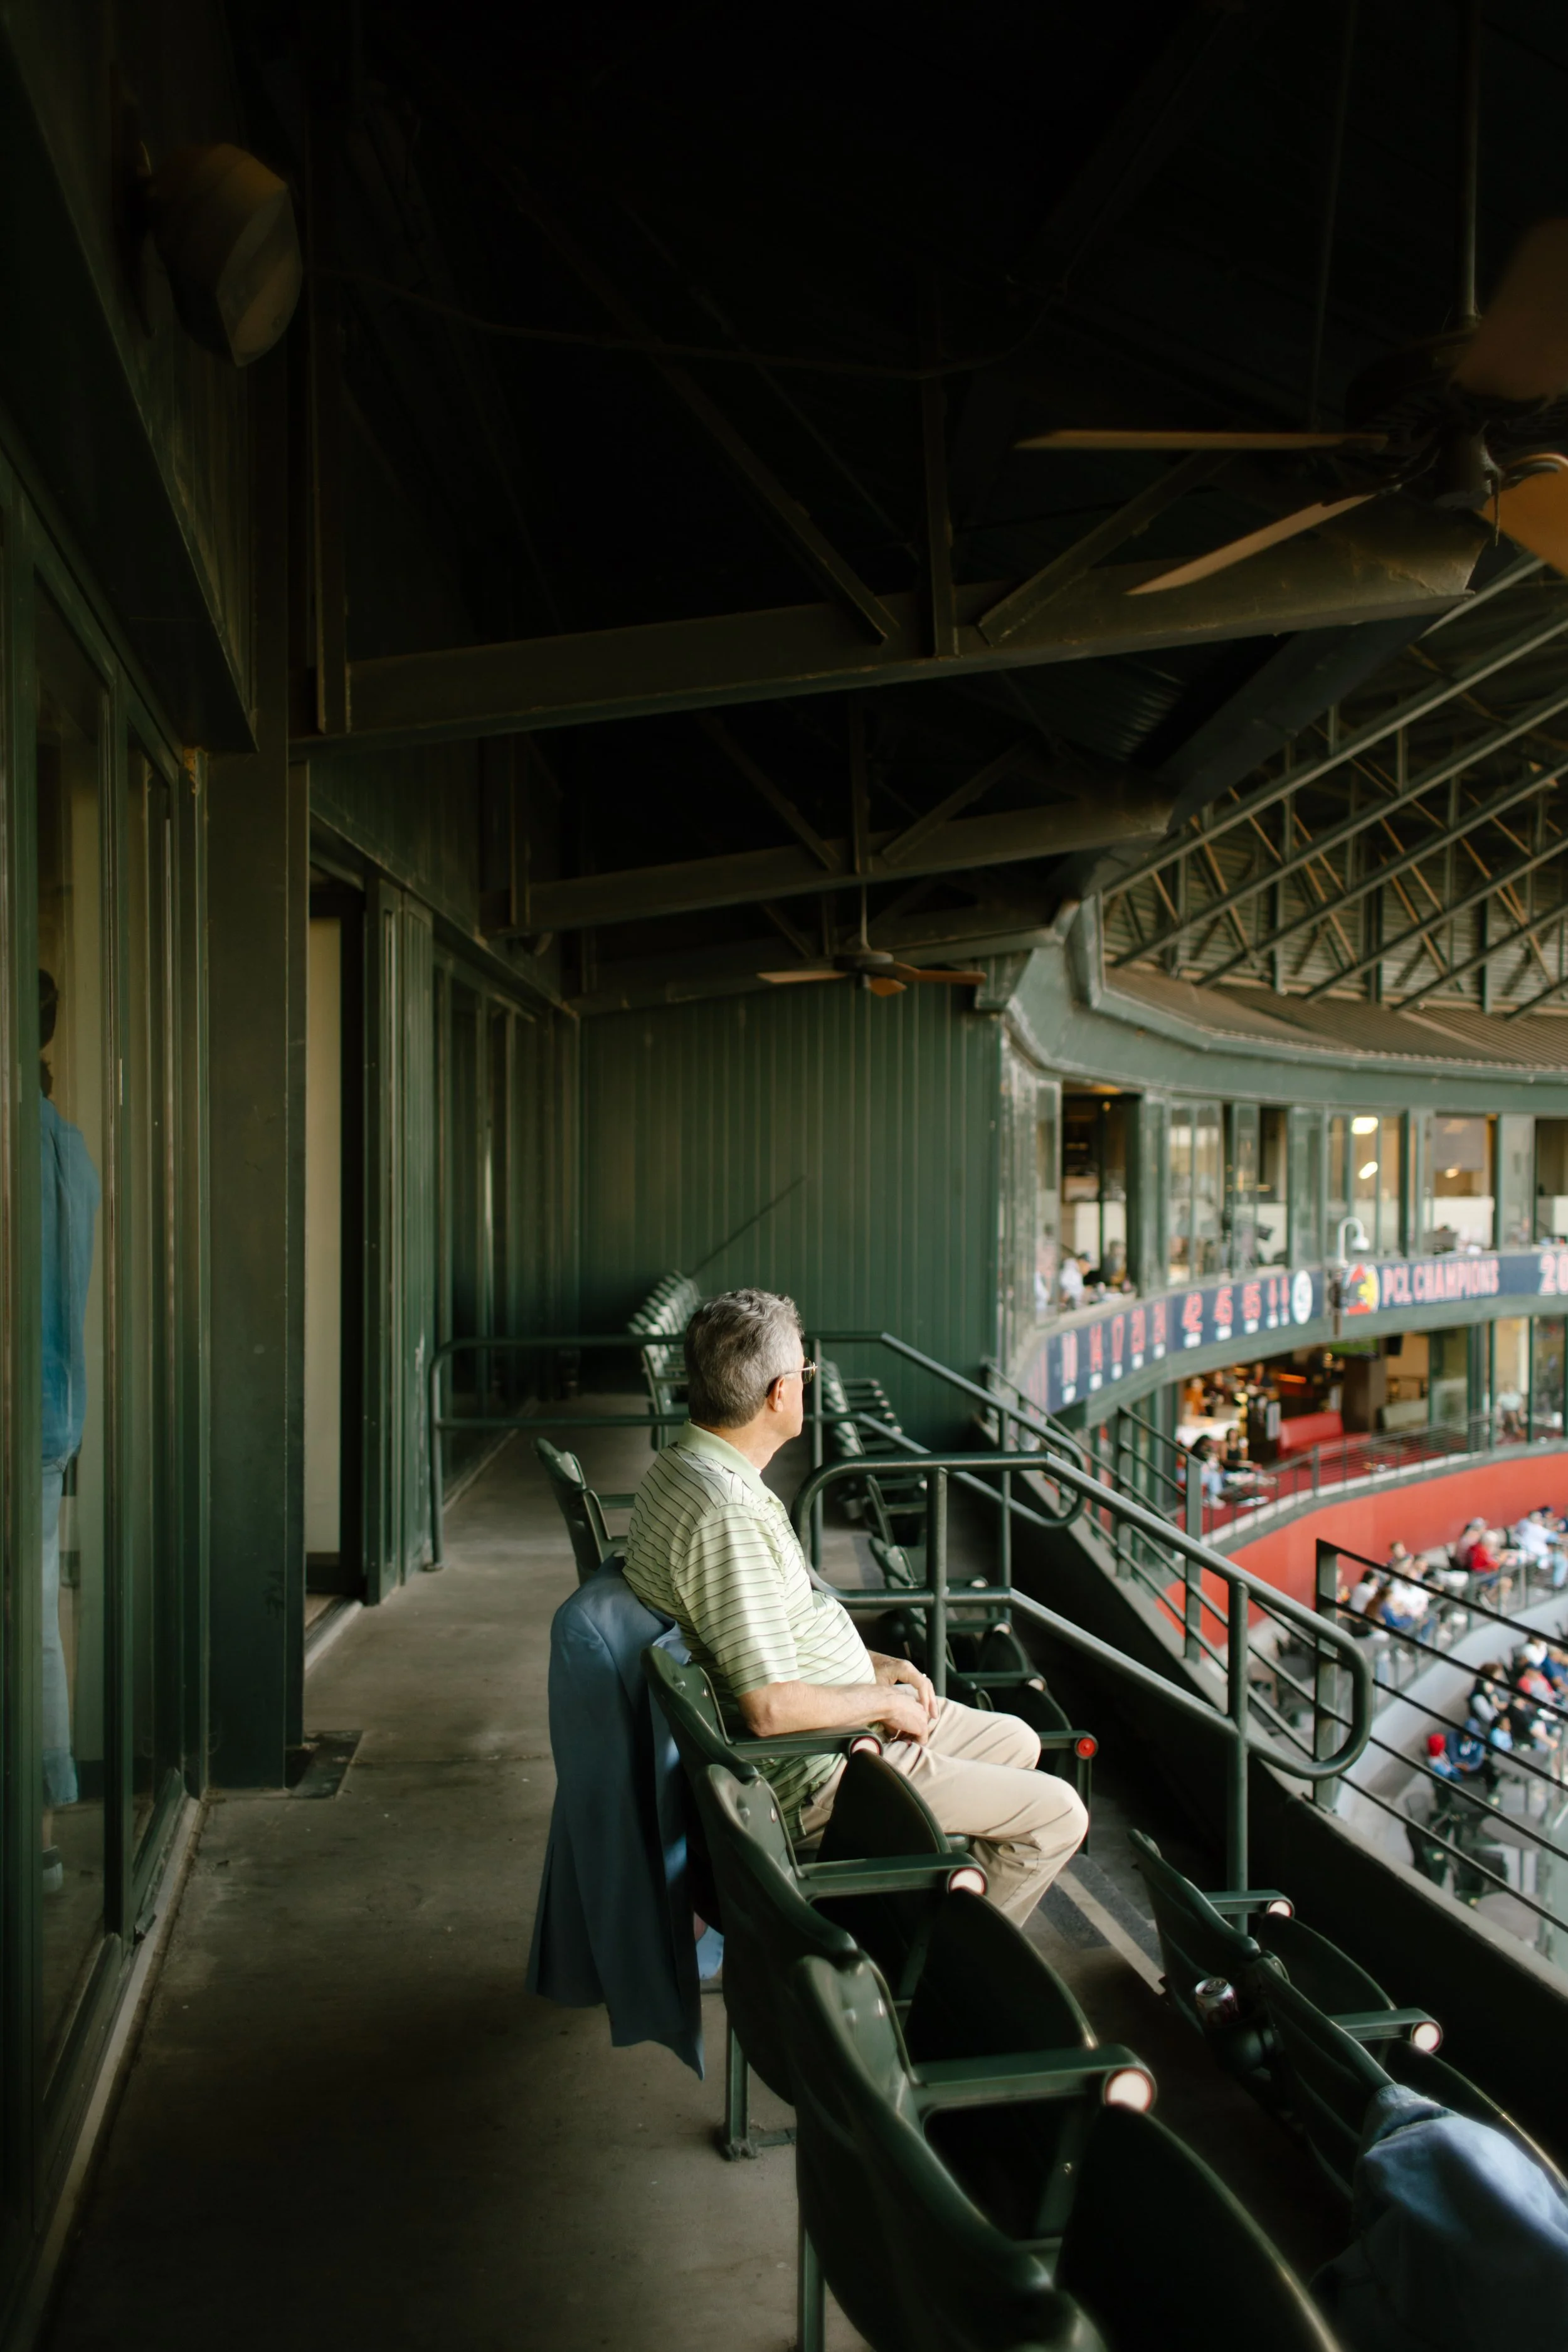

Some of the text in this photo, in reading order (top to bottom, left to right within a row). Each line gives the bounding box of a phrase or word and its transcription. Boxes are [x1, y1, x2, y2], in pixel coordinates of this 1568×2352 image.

[1242, 1281, 1261, 1320] 85
[1382, 1257, 1499, 1306] PCL CHAMPIONS
[1182, 1292, 1203, 1333] 42
[1214, 1286, 1232, 1327] 45
